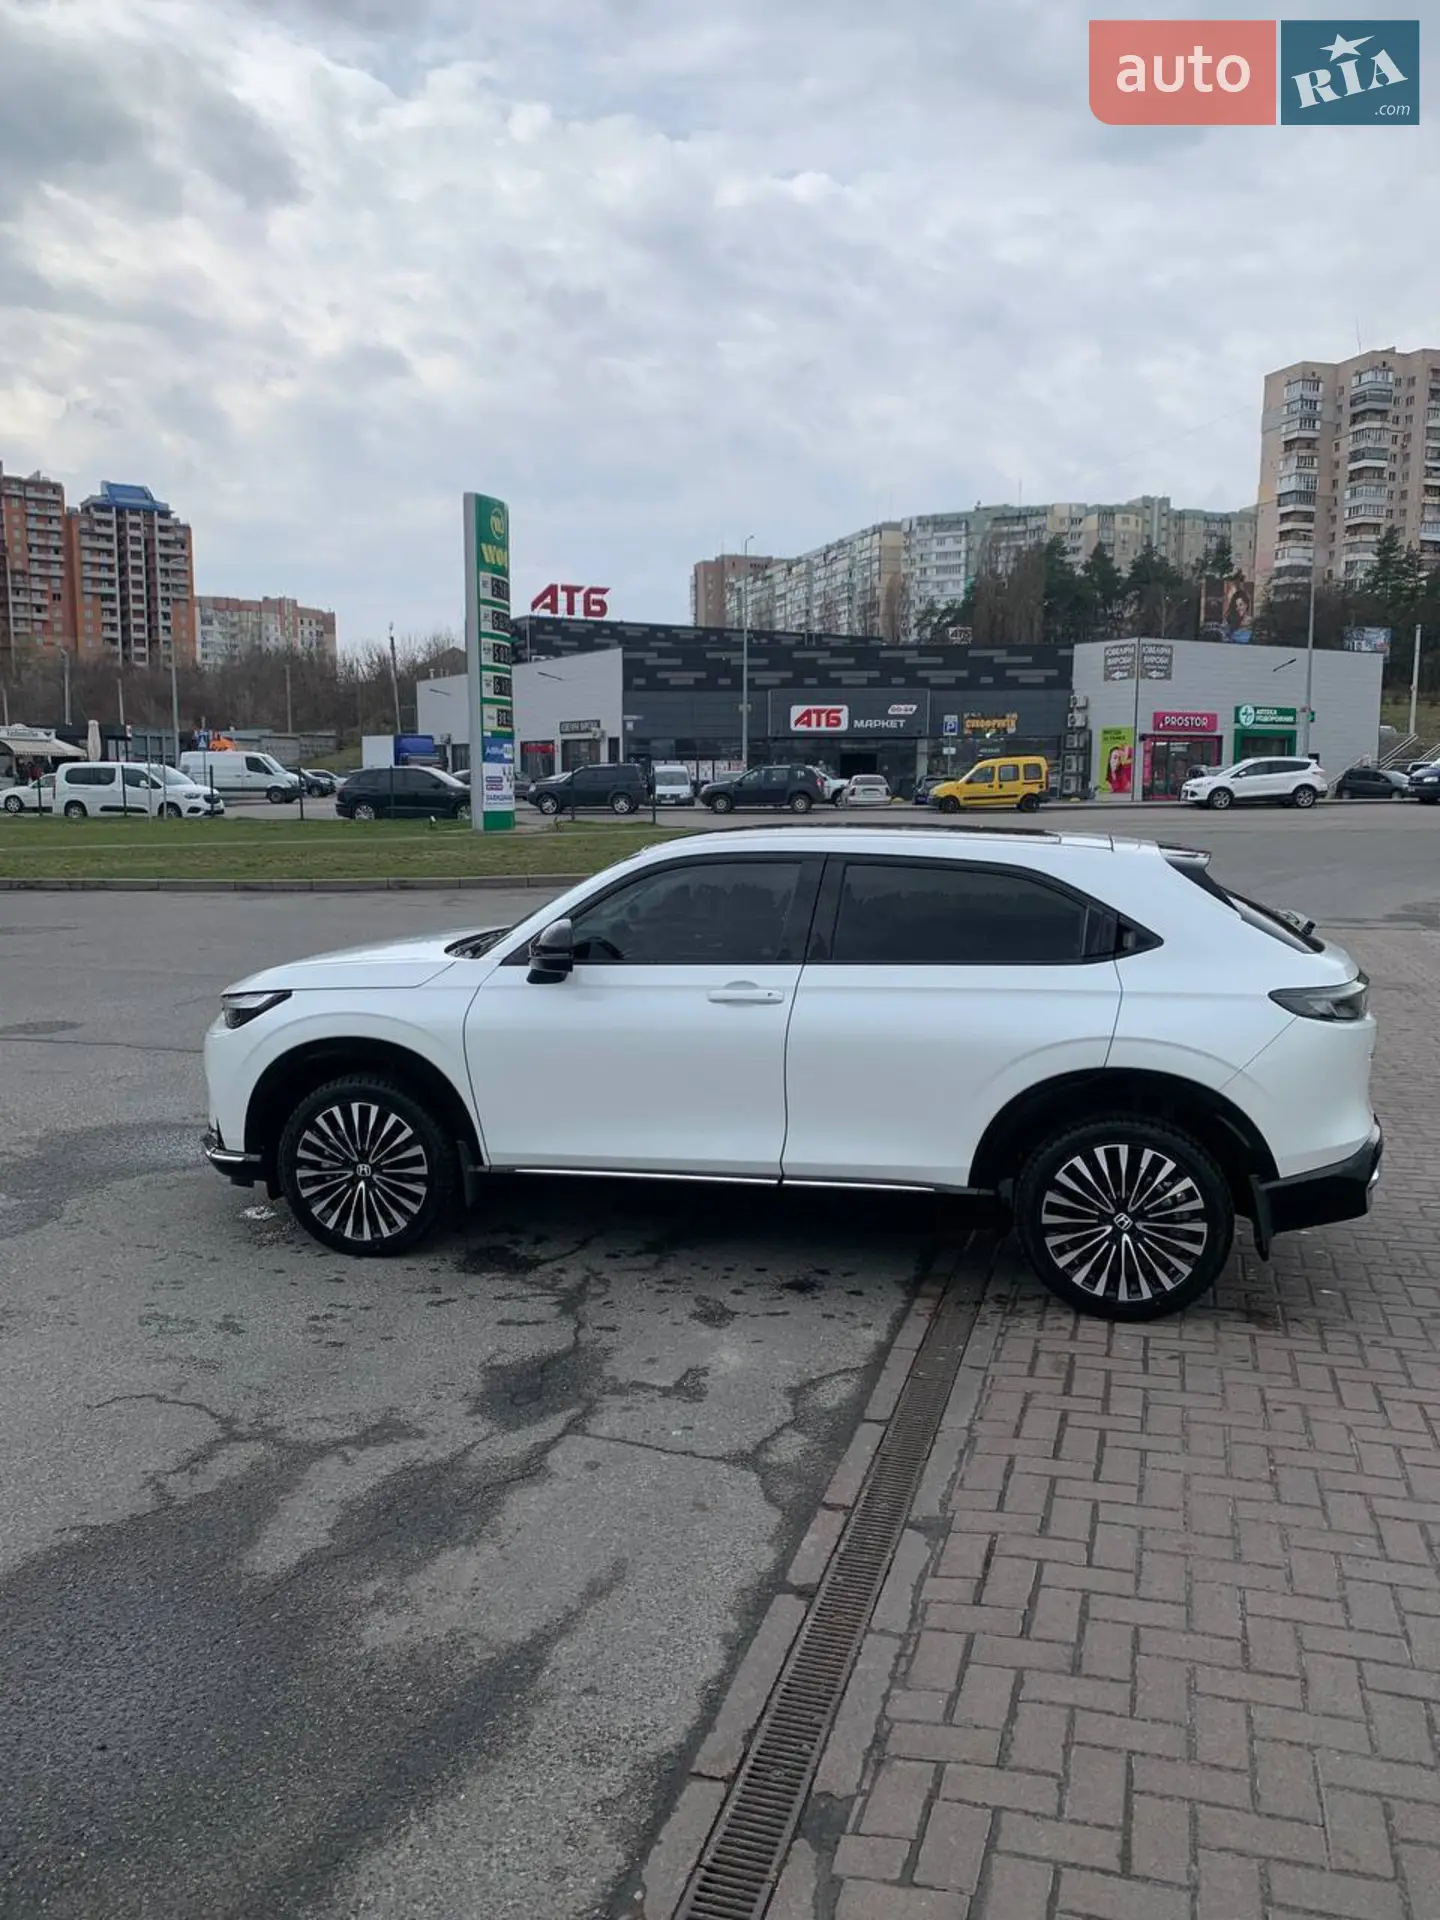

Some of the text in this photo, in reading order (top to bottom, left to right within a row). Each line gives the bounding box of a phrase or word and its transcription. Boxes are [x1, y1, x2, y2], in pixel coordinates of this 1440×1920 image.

[530, 583, 611, 618] АТБ
[794, 708, 844, 728] АТБ
[1164, 716, 1208, 727] PROSTOR
[853, 719, 906, 729] МАРКЕТ
[946, 722, 955, 733] P
